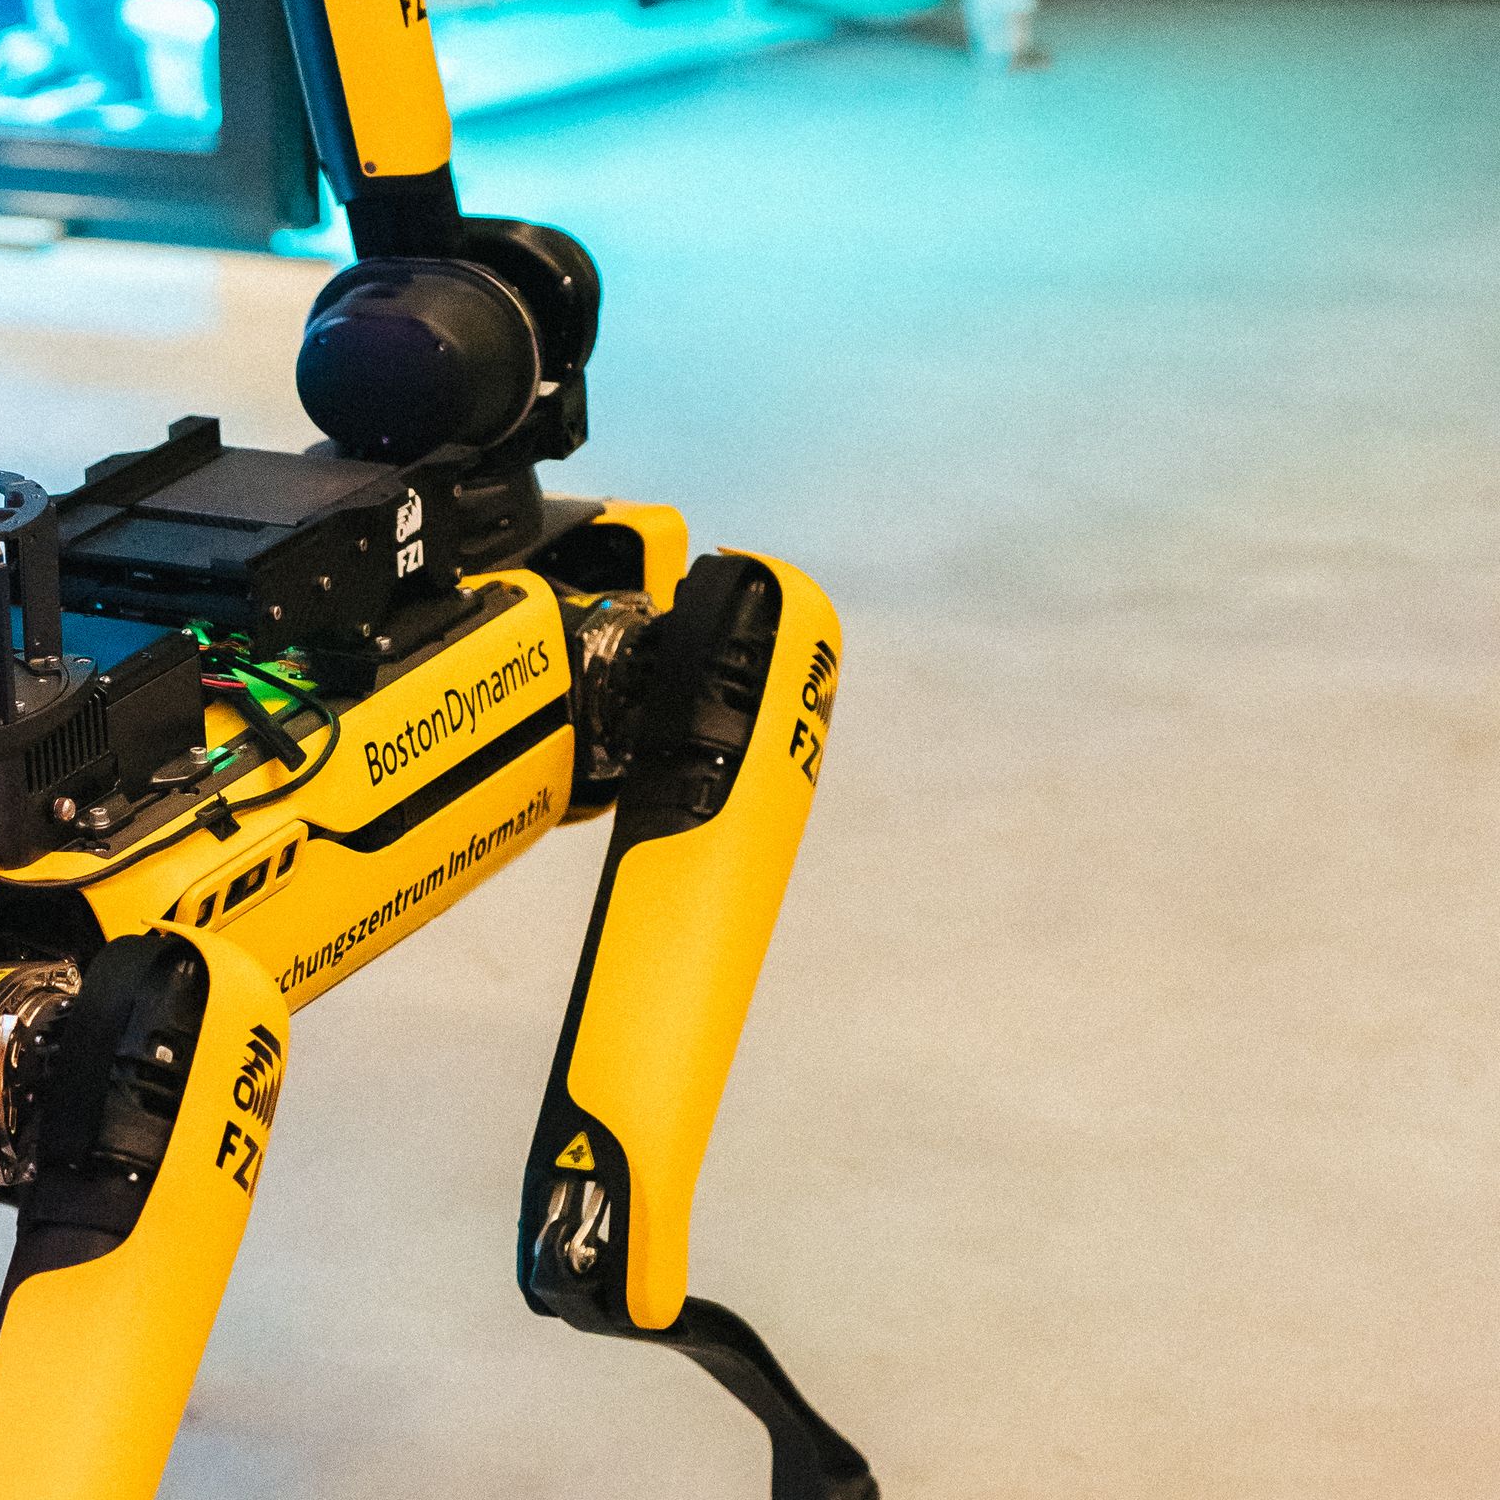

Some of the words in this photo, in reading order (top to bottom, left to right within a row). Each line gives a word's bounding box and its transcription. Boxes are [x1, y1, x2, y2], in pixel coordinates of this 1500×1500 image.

[397, 540, 424, 577] FZI
[274, 861, 444, 994] chungszentrum
[447, 786, 555, 881] Informatik
